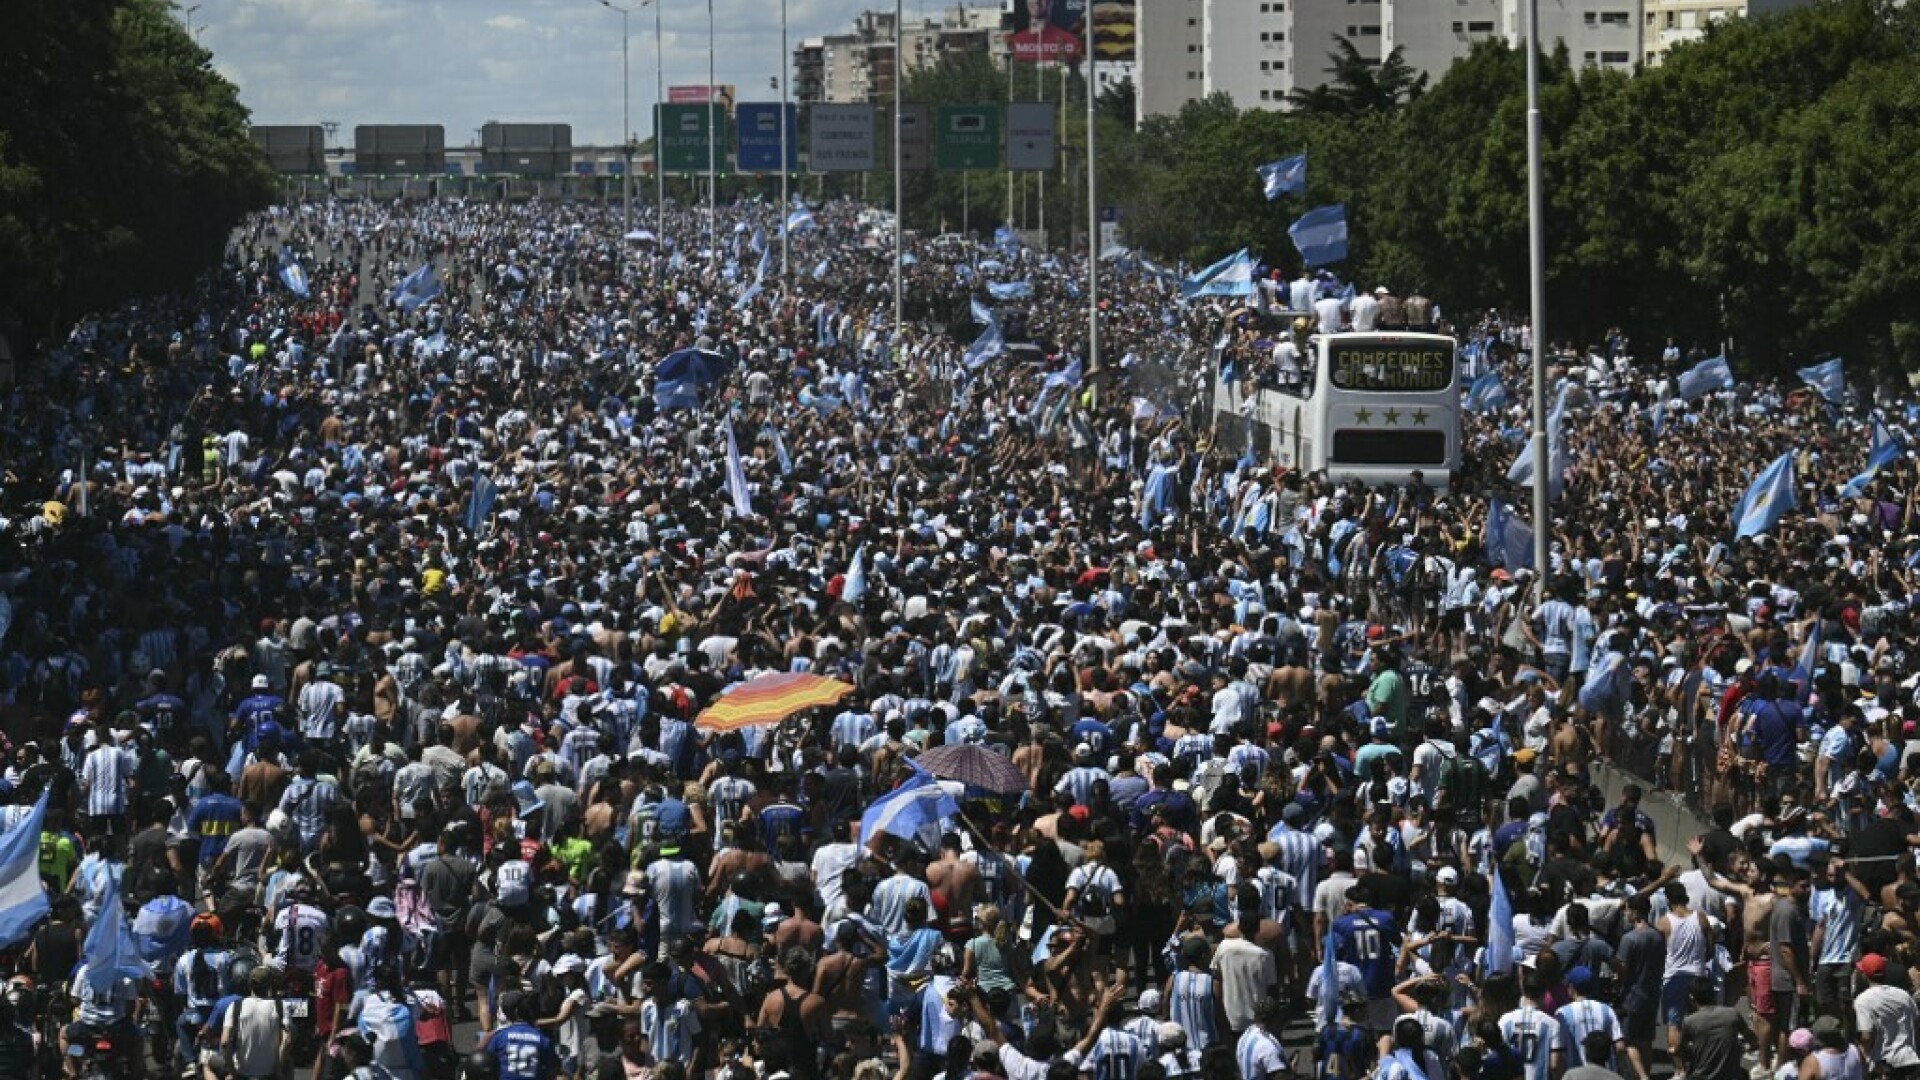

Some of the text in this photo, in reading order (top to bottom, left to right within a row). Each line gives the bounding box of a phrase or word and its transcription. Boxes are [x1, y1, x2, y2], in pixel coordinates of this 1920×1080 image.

[1337, 351, 1444, 369] CAMPEONES
[1409, 673, 1430, 696] 16
[300, 926, 314, 956] 8
[1352, 929, 1379, 960] 10
